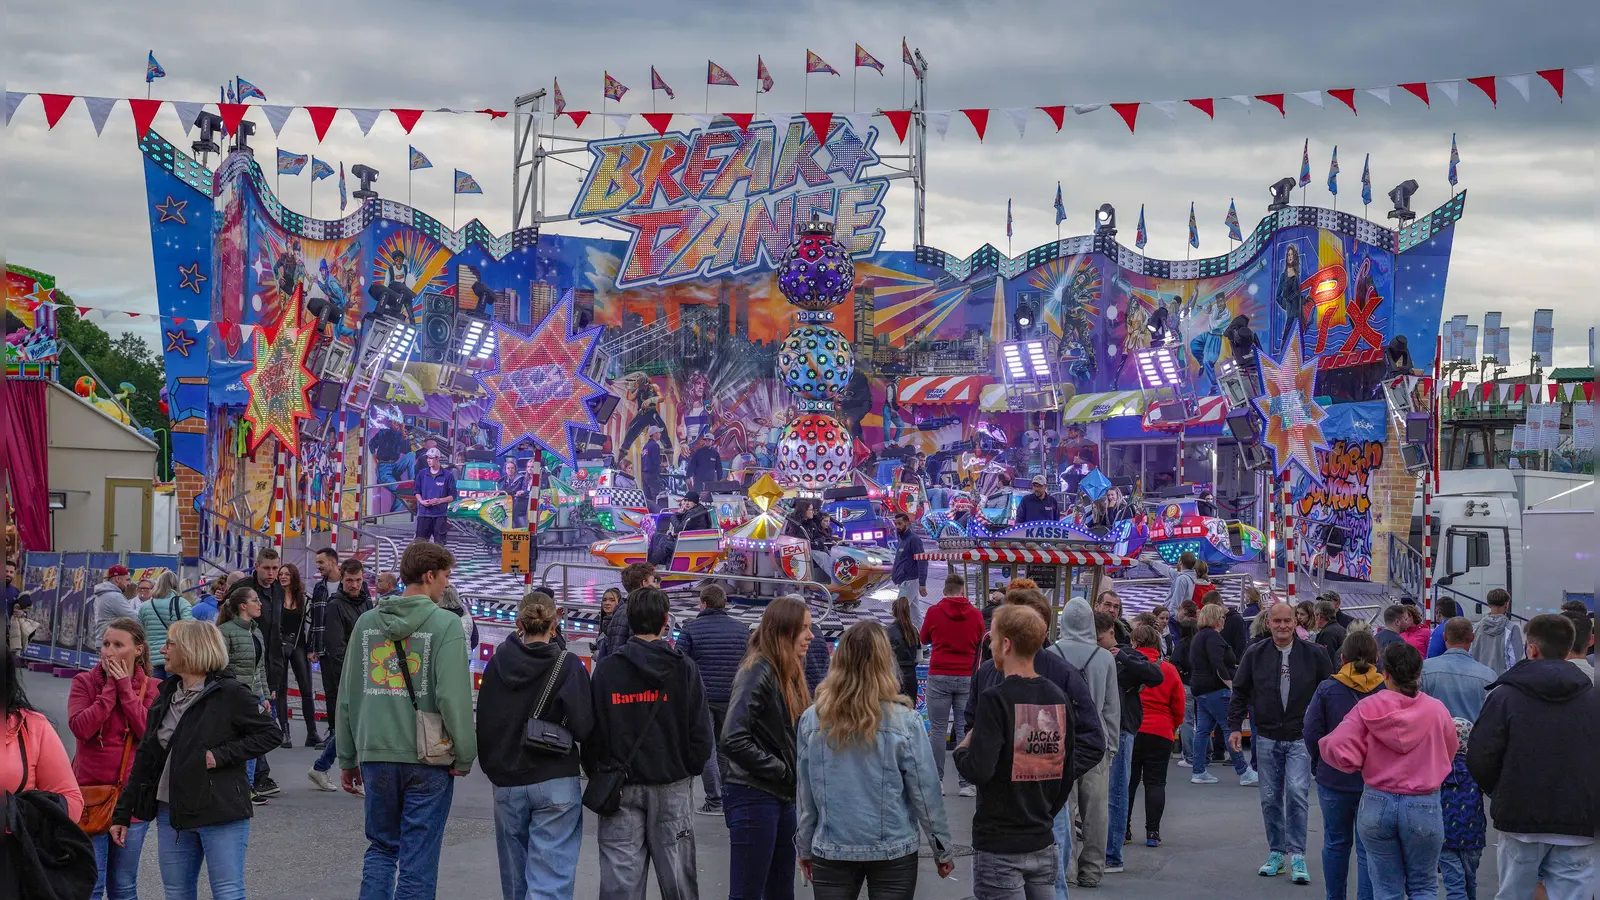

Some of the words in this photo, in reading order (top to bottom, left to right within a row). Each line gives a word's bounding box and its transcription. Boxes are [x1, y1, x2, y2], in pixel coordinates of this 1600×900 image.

[573, 119, 842, 217] BREAK
[903, 485, 920, 493] FCA
[1025, 526, 1070, 540] KASSE
[783, 543, 803, 555] FCA
[1026, 743, 1059, 754] JONES
